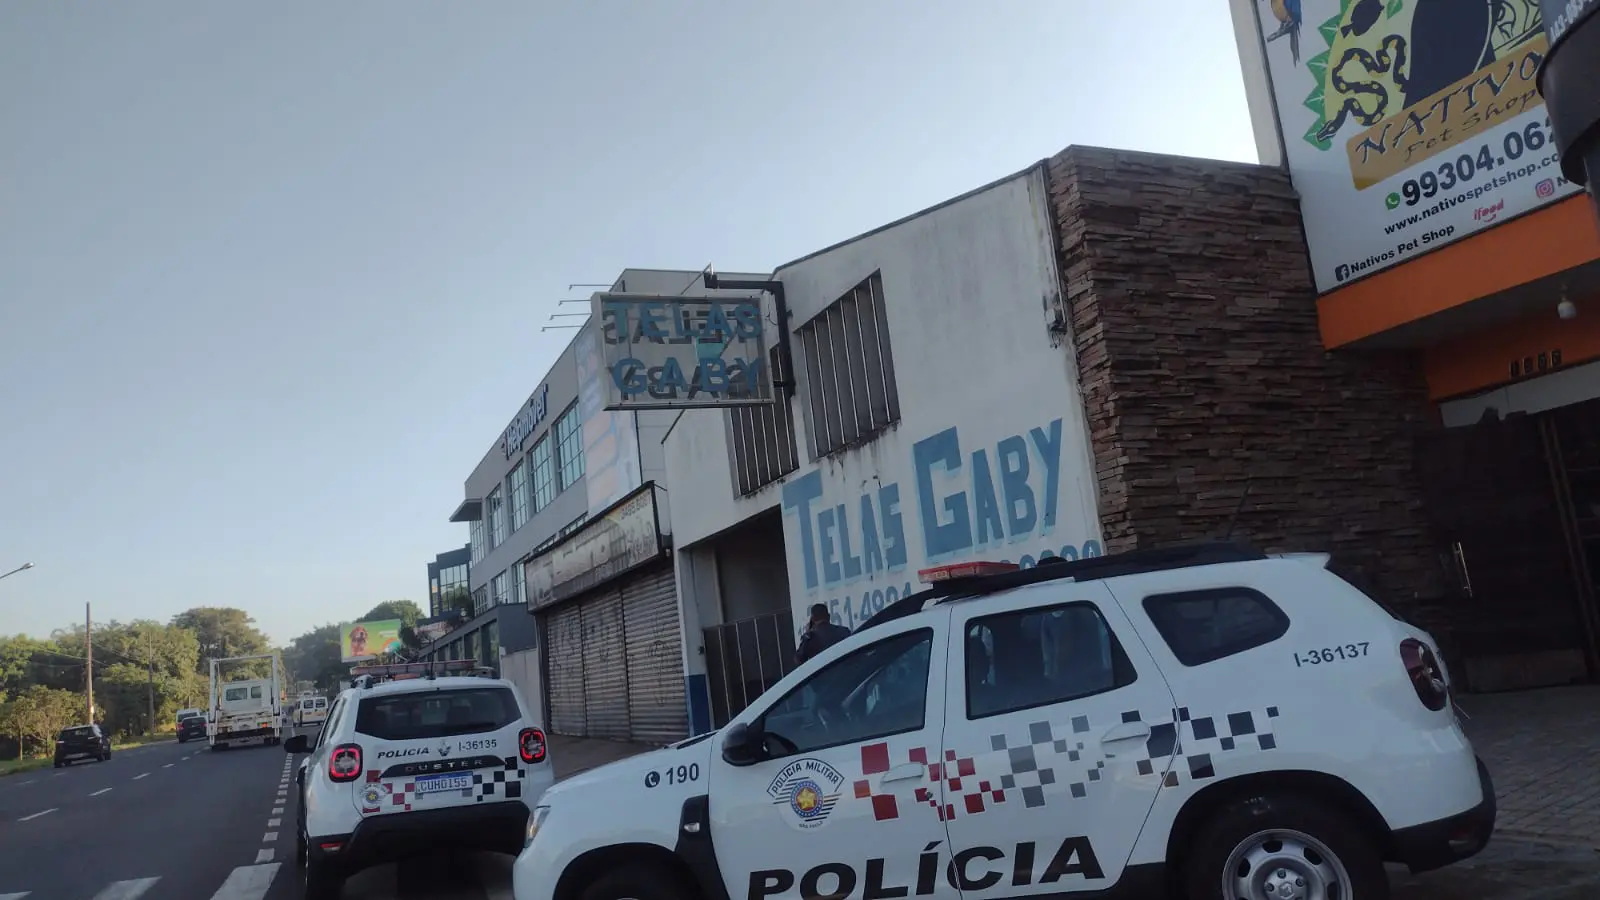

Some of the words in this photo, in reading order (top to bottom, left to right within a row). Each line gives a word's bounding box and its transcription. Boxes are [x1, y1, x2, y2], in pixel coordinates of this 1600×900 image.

[1404, 128, 1453, 163] Pet
[1462, 89, 1537, 132] Shop
[1350, 249, 1395, 273] Nativos
[1397, 238, 1419, 254] Pet
[1421, 224, 1455, 244] Shop
[602, 302, 763, 339] TELAS
[612, 357, 763, 395] GABY
[1293, 642, 1370, 668] I-36137
[458, 739, 497, 752] I-36135
[404, 759, 483, 772] DUSTER
[665, 762, 700, 785] 190
[805, 761, 840, 785] MILITAR
[747, 835, 1106, 900] POLÍCIA
